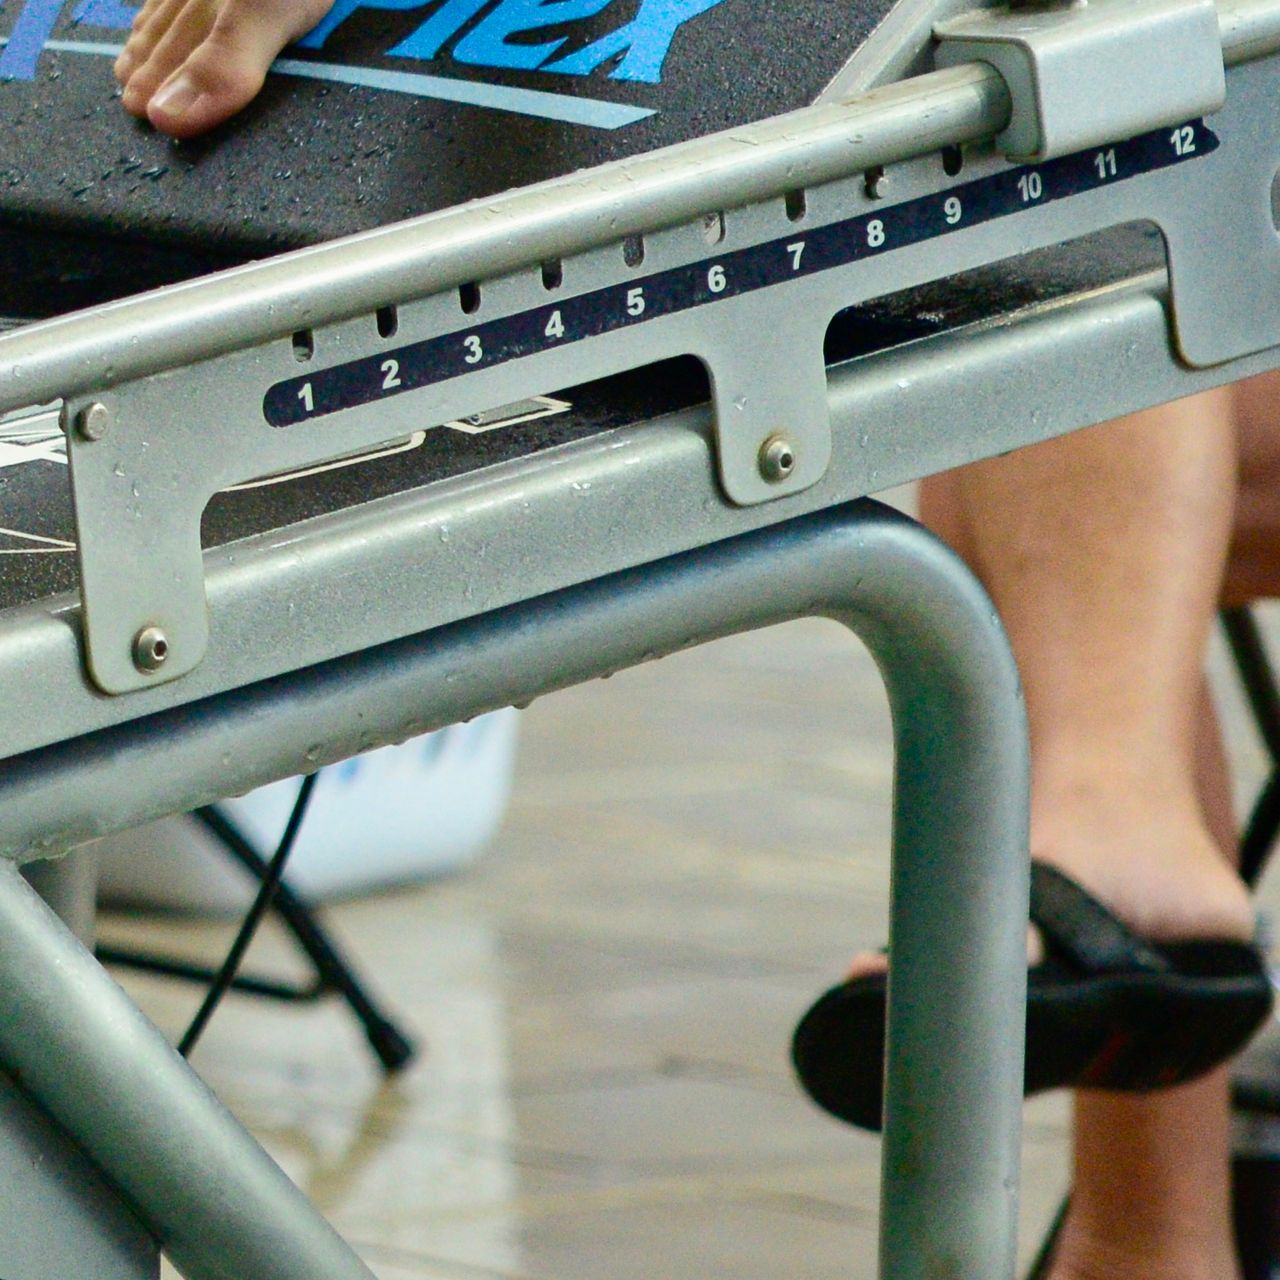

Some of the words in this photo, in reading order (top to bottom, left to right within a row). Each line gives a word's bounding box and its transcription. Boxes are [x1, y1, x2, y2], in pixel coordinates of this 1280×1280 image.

[297, 382, 315, 412] 1
[380, 359, 402, 390] 2
[463, 335, 484, 364] 3
[543, 310, 565, 339] 4
[626, 287, 646, 316] 5
[706, 264, 727, 293] 6
[786, 241, 806, 271] 7
[866, 219, 886, 248] 8
[943, 196, 963, 225] 9
[1017, 171, 1042, 202] 10
[1094, 148, 1118, 180] 11
[1169, 125, 1197, 157] 12
